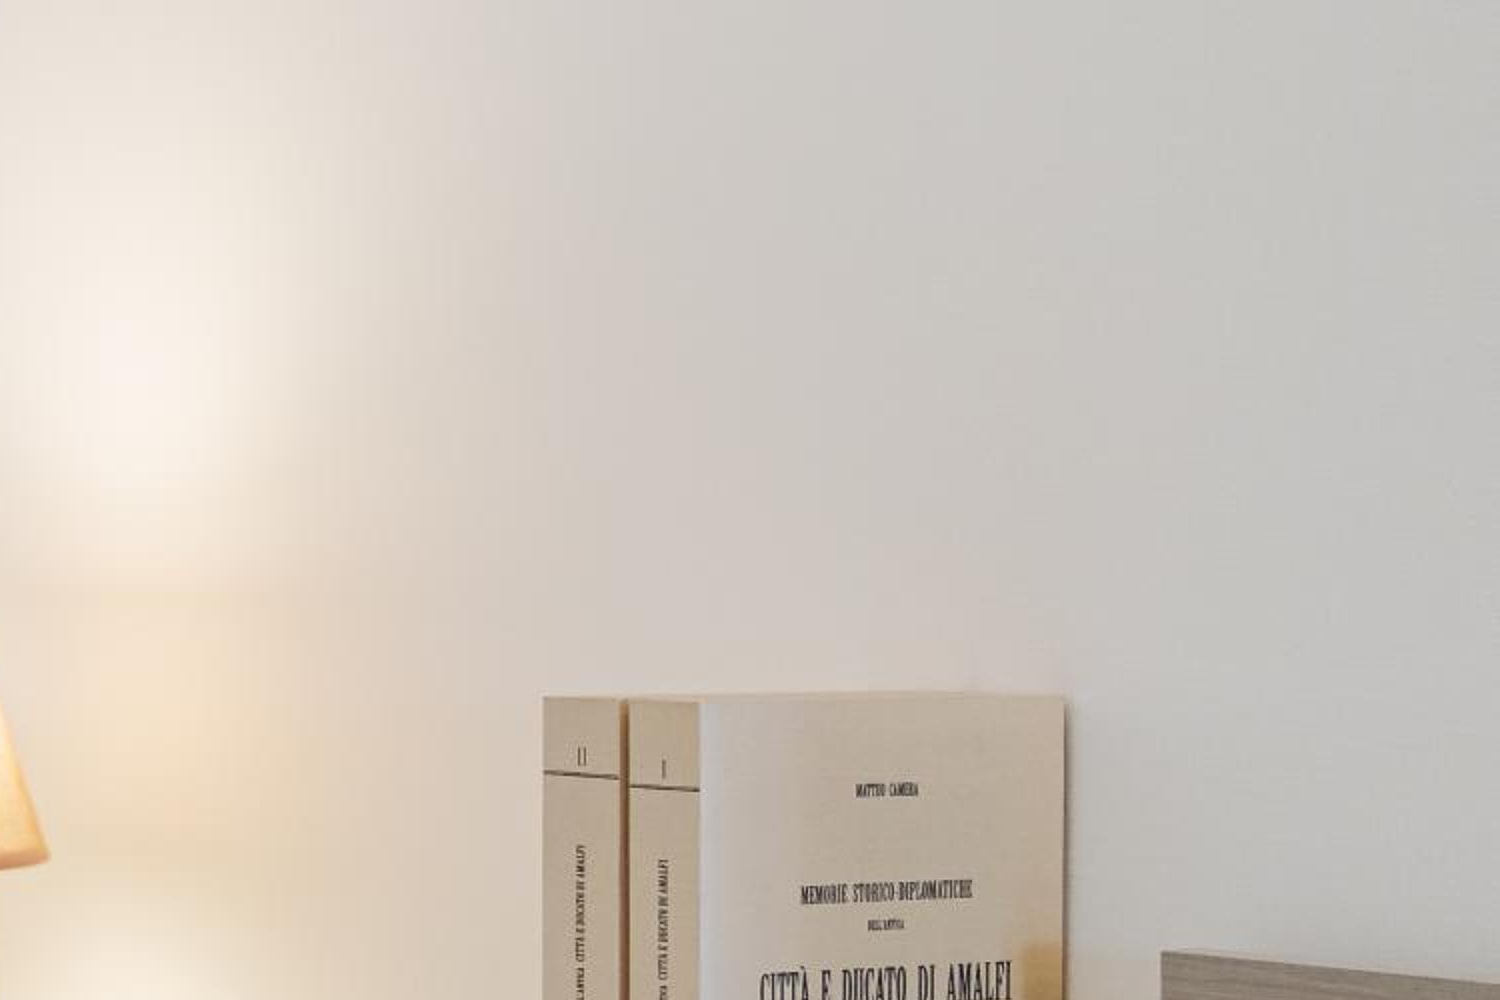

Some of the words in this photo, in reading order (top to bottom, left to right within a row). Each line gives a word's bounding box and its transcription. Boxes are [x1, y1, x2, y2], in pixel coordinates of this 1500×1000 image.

[855, 784, 885, 798] MATTEO
[889, 782, 919, 797] CAMERA
[575, 844, 587, 879] AMALFI
[575, 880, 586, 891] DI
[657, 858, 669, 895] AMALFI
[575, 891, 586, 926] DUCATO
[657, 895, 669, 907] DI
[801, 884, 847, 905] MEMORIE
[657, 907, 669, 943] DUCATO
